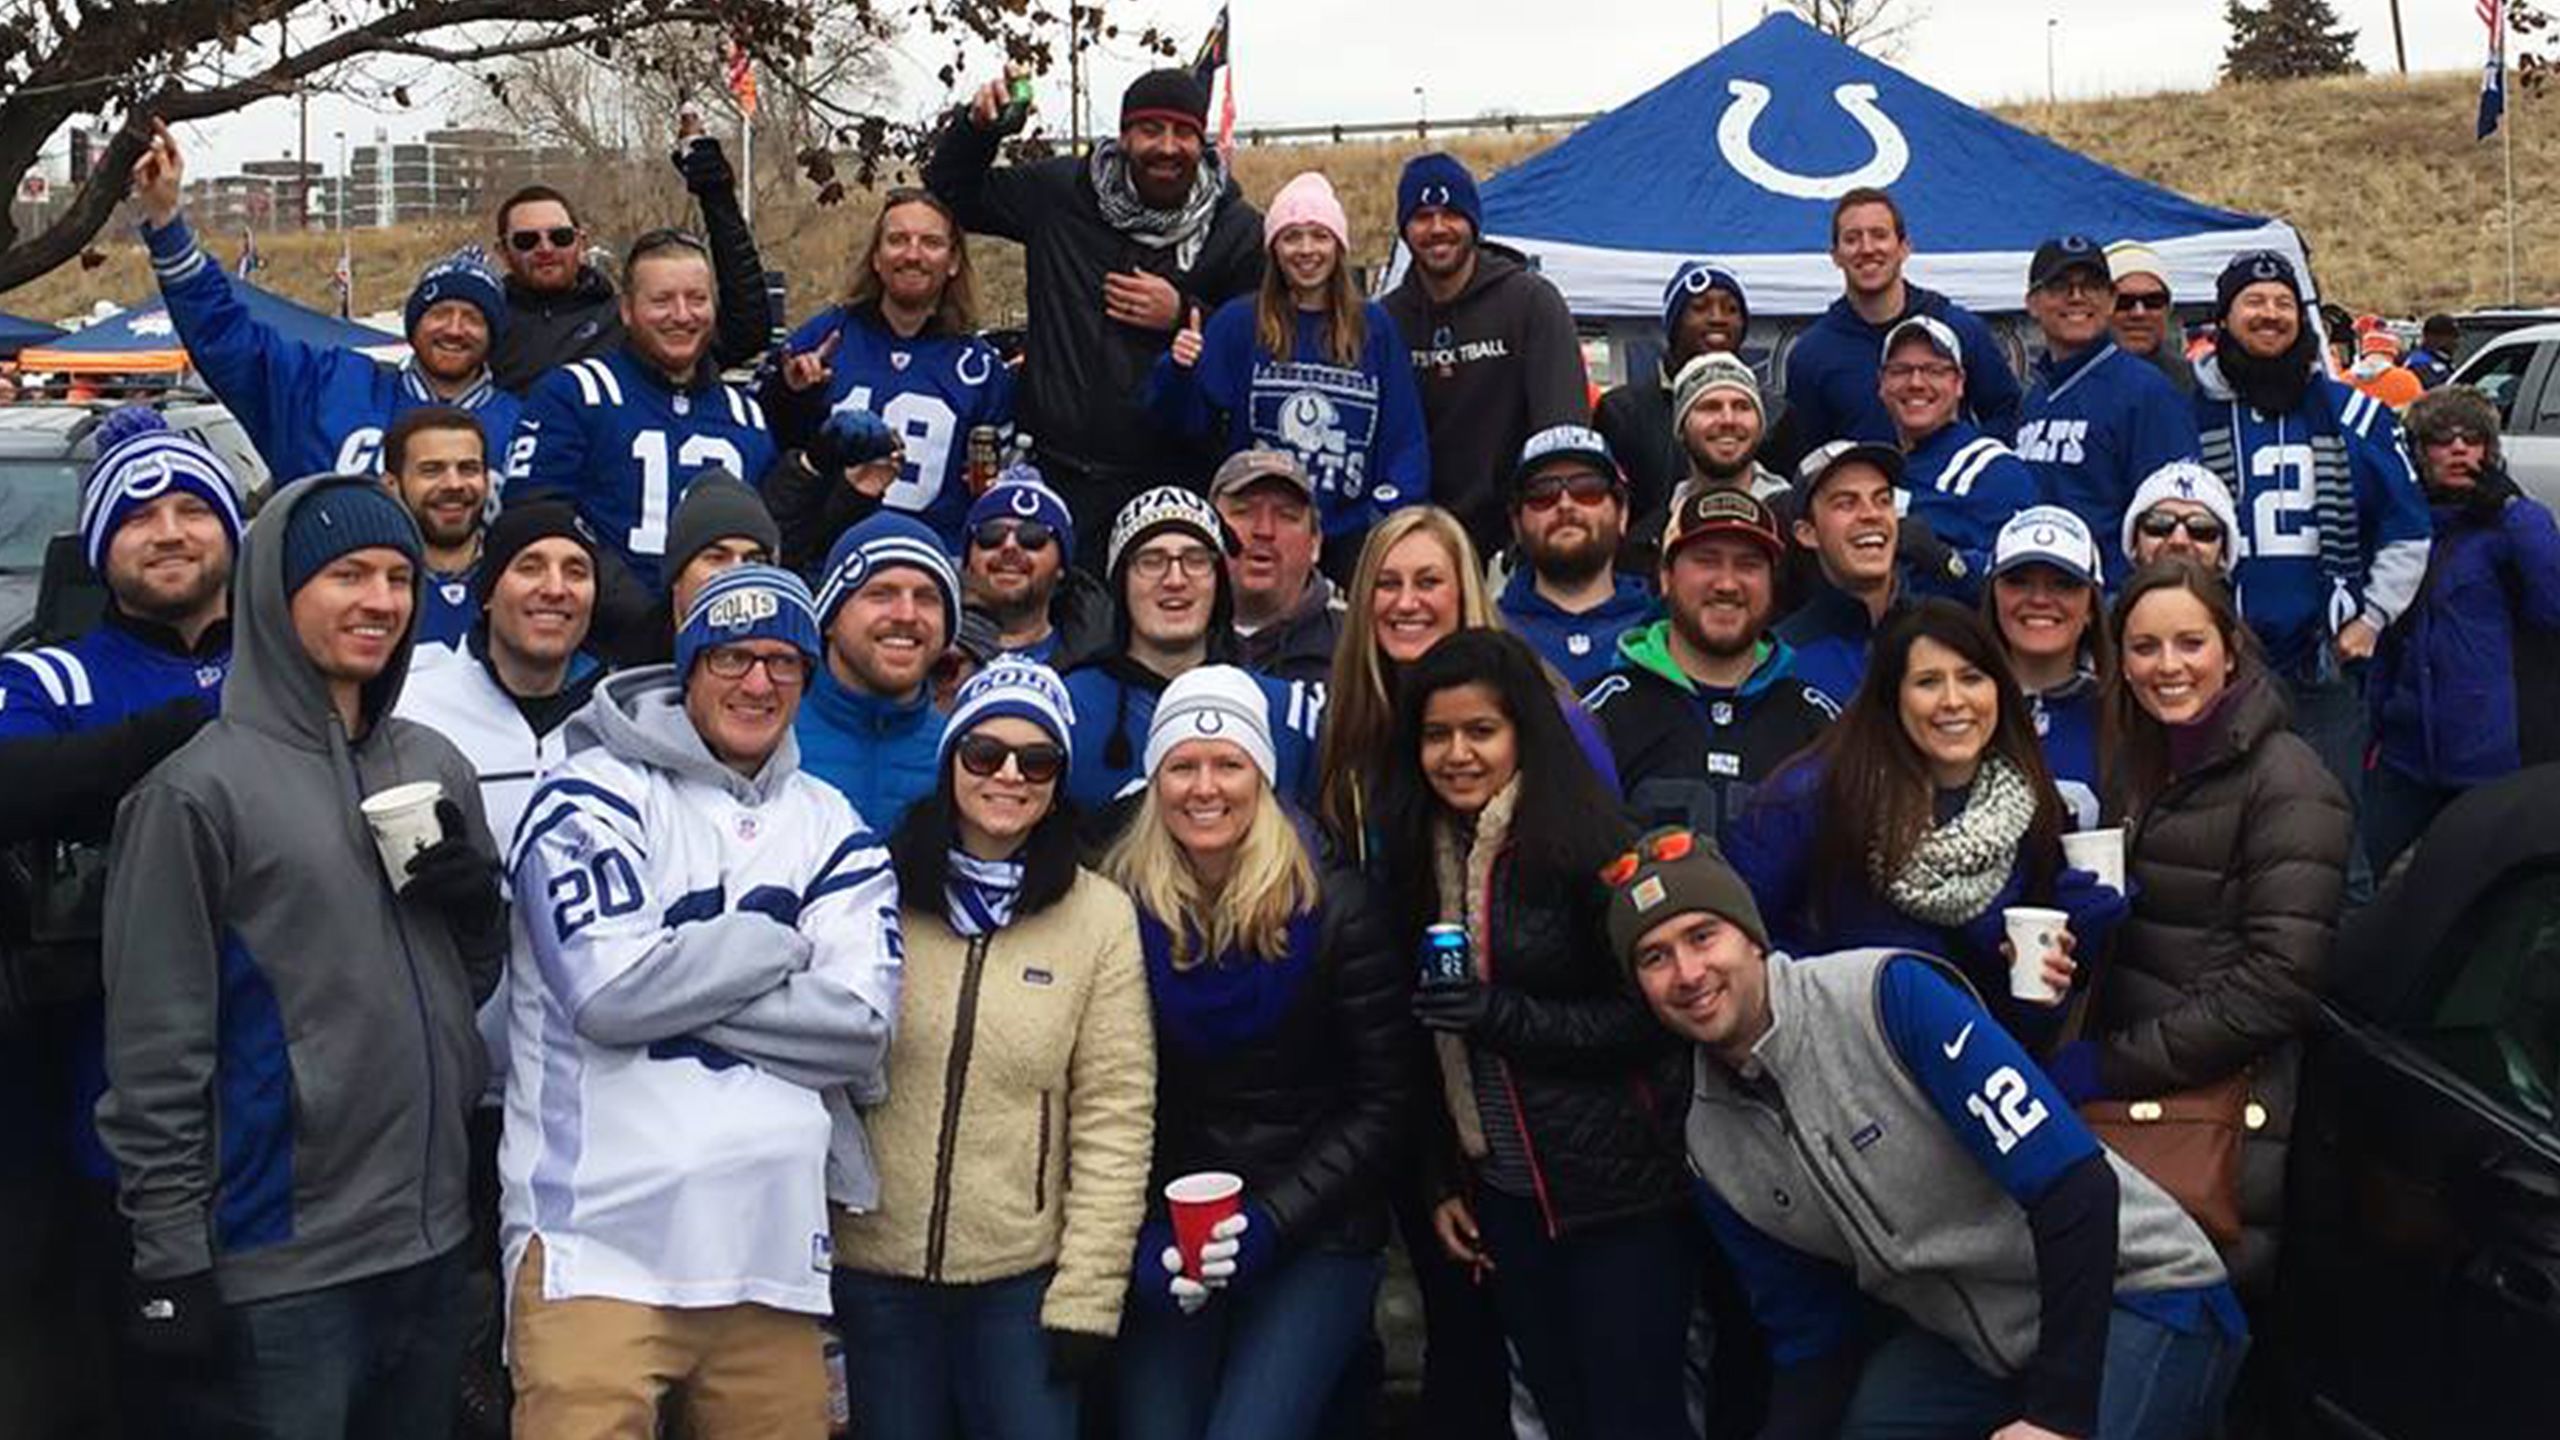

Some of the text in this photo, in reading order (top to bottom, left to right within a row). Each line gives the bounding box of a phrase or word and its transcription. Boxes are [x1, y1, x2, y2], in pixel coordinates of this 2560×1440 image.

[2017, 419, 2088, 463] OLTS
[2240, 443, 2321, 557] 2
[709, 589, 777, 626] COLTS
[548, 847, 645, 943] 20
[1966, 1065, 2050, 1155] 12
